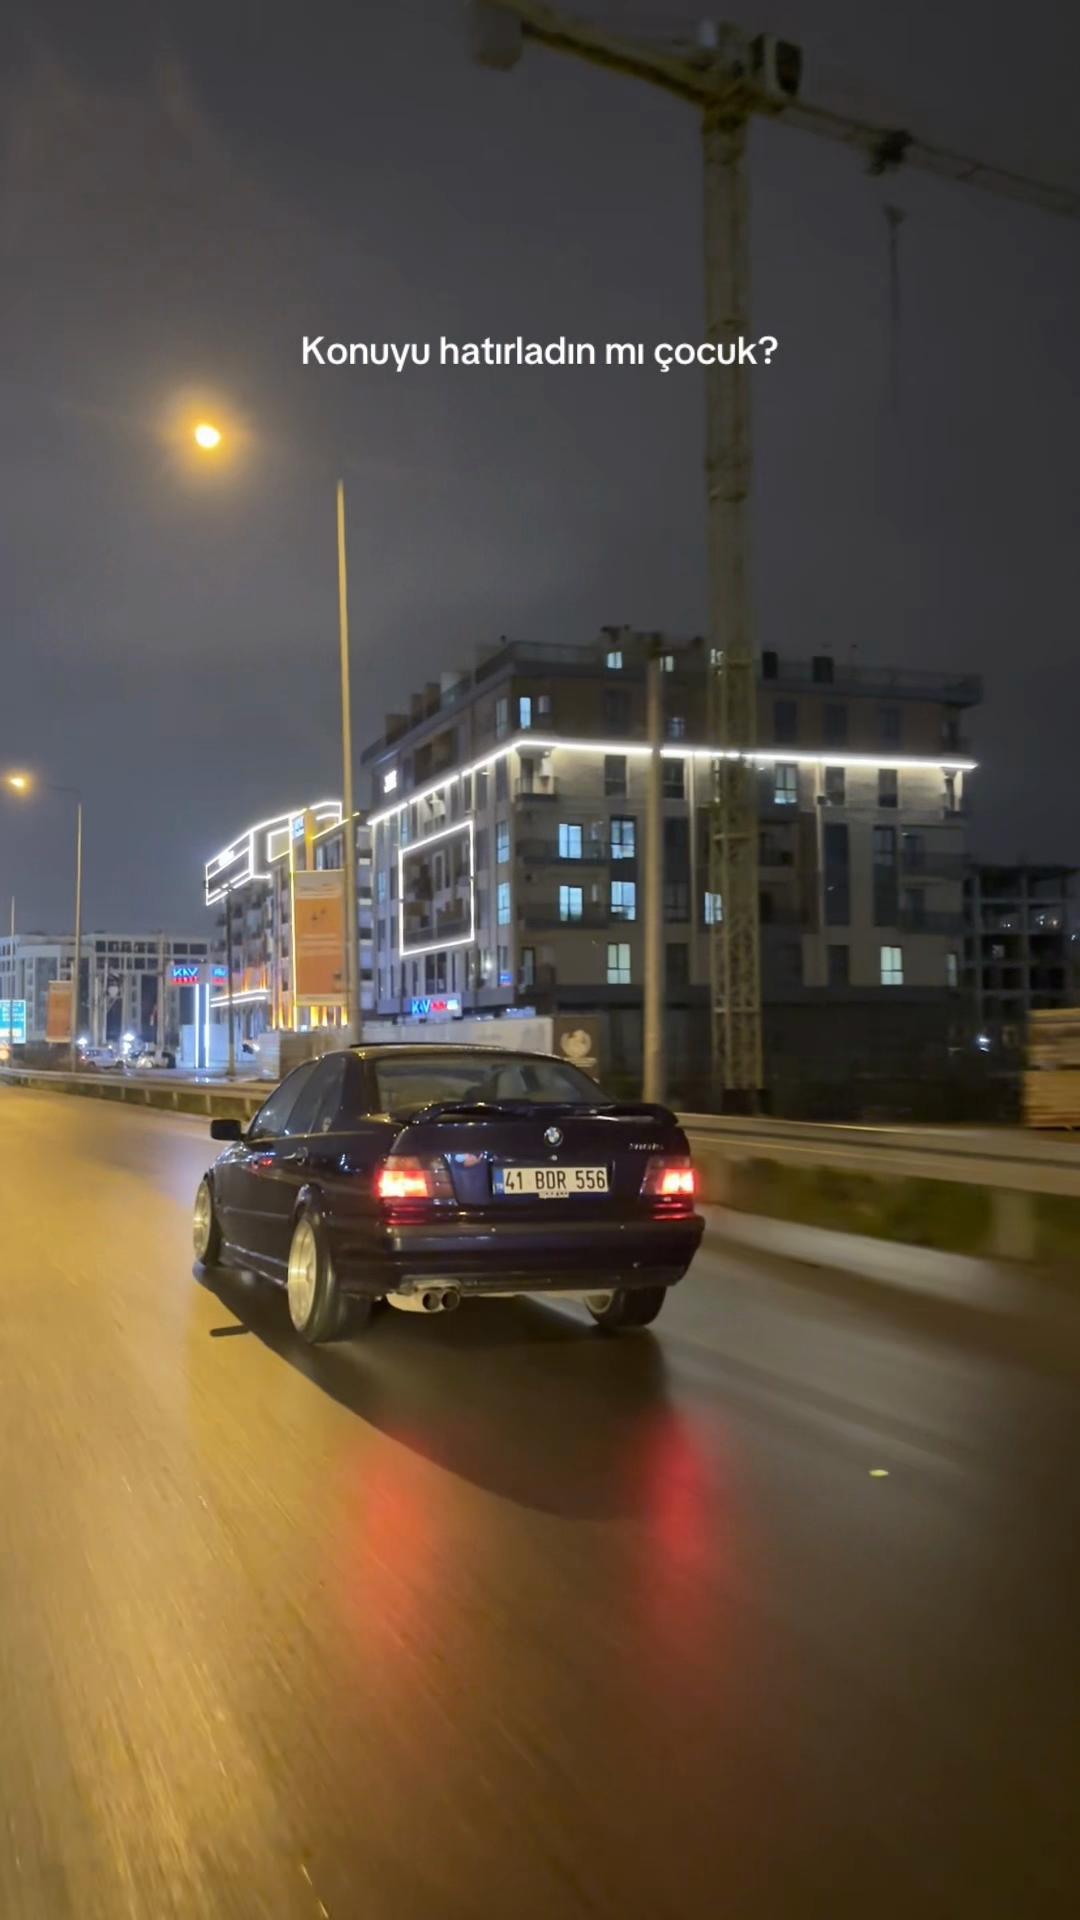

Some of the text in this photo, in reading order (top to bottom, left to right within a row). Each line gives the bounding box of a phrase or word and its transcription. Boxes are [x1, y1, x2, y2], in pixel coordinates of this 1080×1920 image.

[505, 1171, 523, 1190] 41
[535, 1170, 566, 1189] BDR
[575, 1170, 606, 1189] 556
